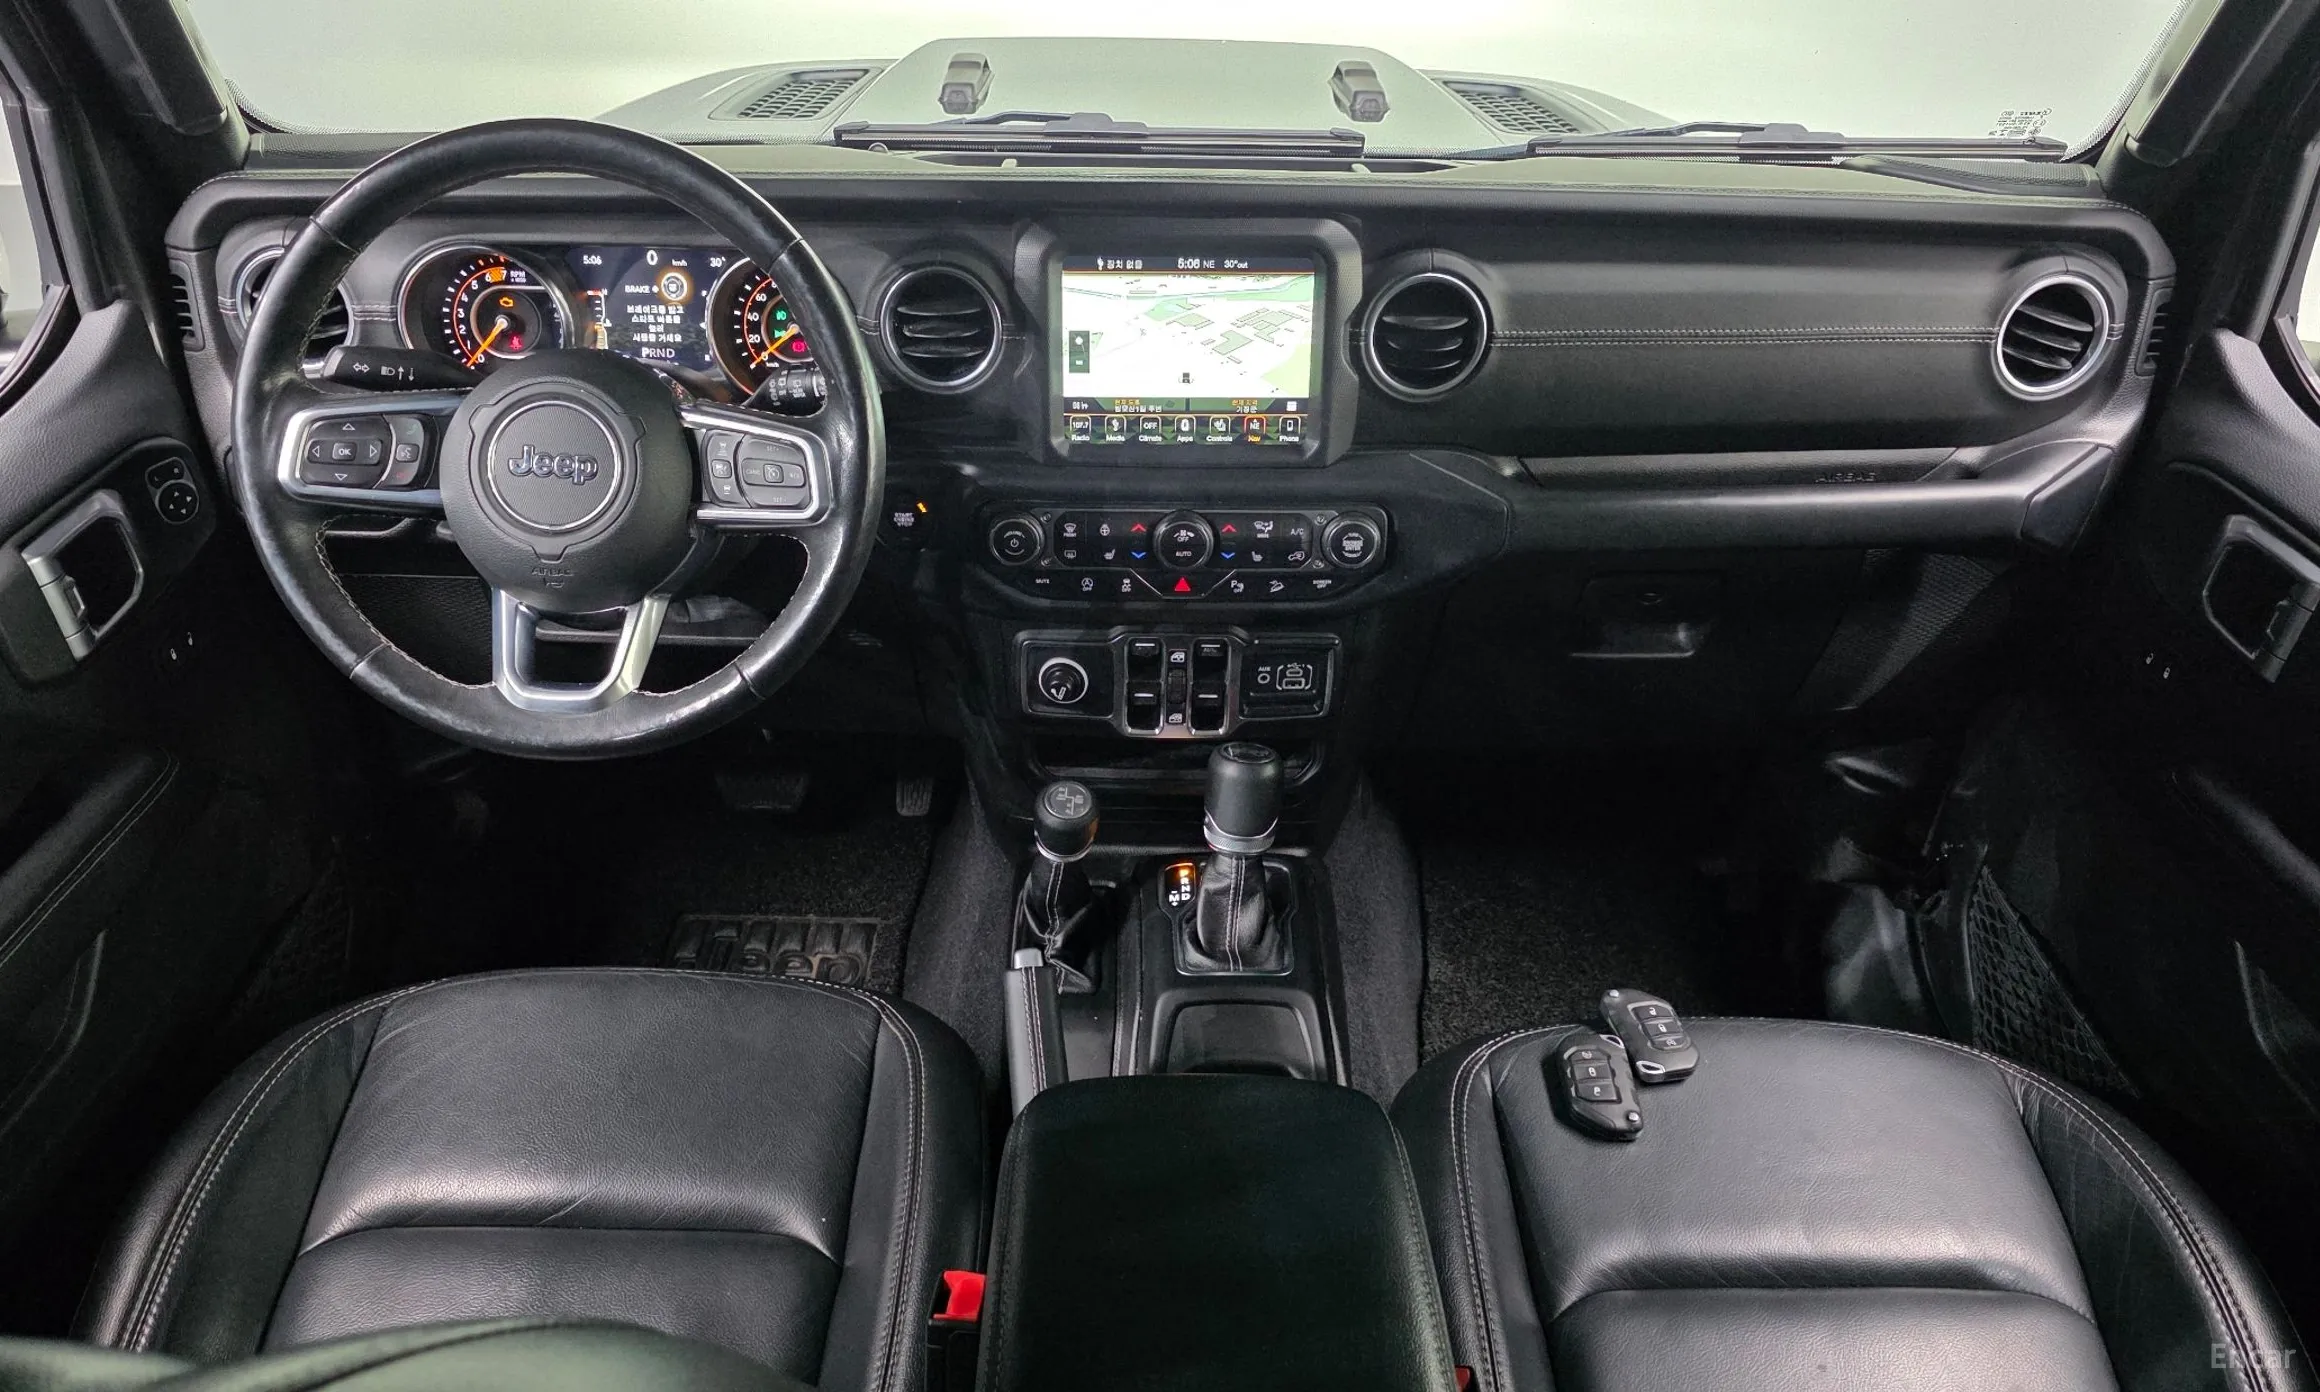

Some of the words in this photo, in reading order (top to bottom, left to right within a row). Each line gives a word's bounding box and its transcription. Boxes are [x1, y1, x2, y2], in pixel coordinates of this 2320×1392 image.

[582, 255, 602, 265] 5:06
[646, 250, 658, 266] 0
[1177, 257, 1200, 269] 5:06
[1203, 260, 1215, 269] NE
[510, 270, 526, 278] RPM
[471, 280, 479, 290] 5
[625, 285, 650, 293] BRAKE
[461, 293, 469, 303] 4
[755, 293, 767, 302] 60
[457, 308, 465, 318] 3
[747, 312, 760, 321] 40
[459, 325, 467, 334] 2
[748, 335, 760, 343] 20
[477, 353, 485, 363] 0
[1177, 434, 1194, 443] Apps
[338, 448, 352, 456] OK
[508, 444, 599, 485] Jeep
[1290, 528, 1305, 536] A/C
